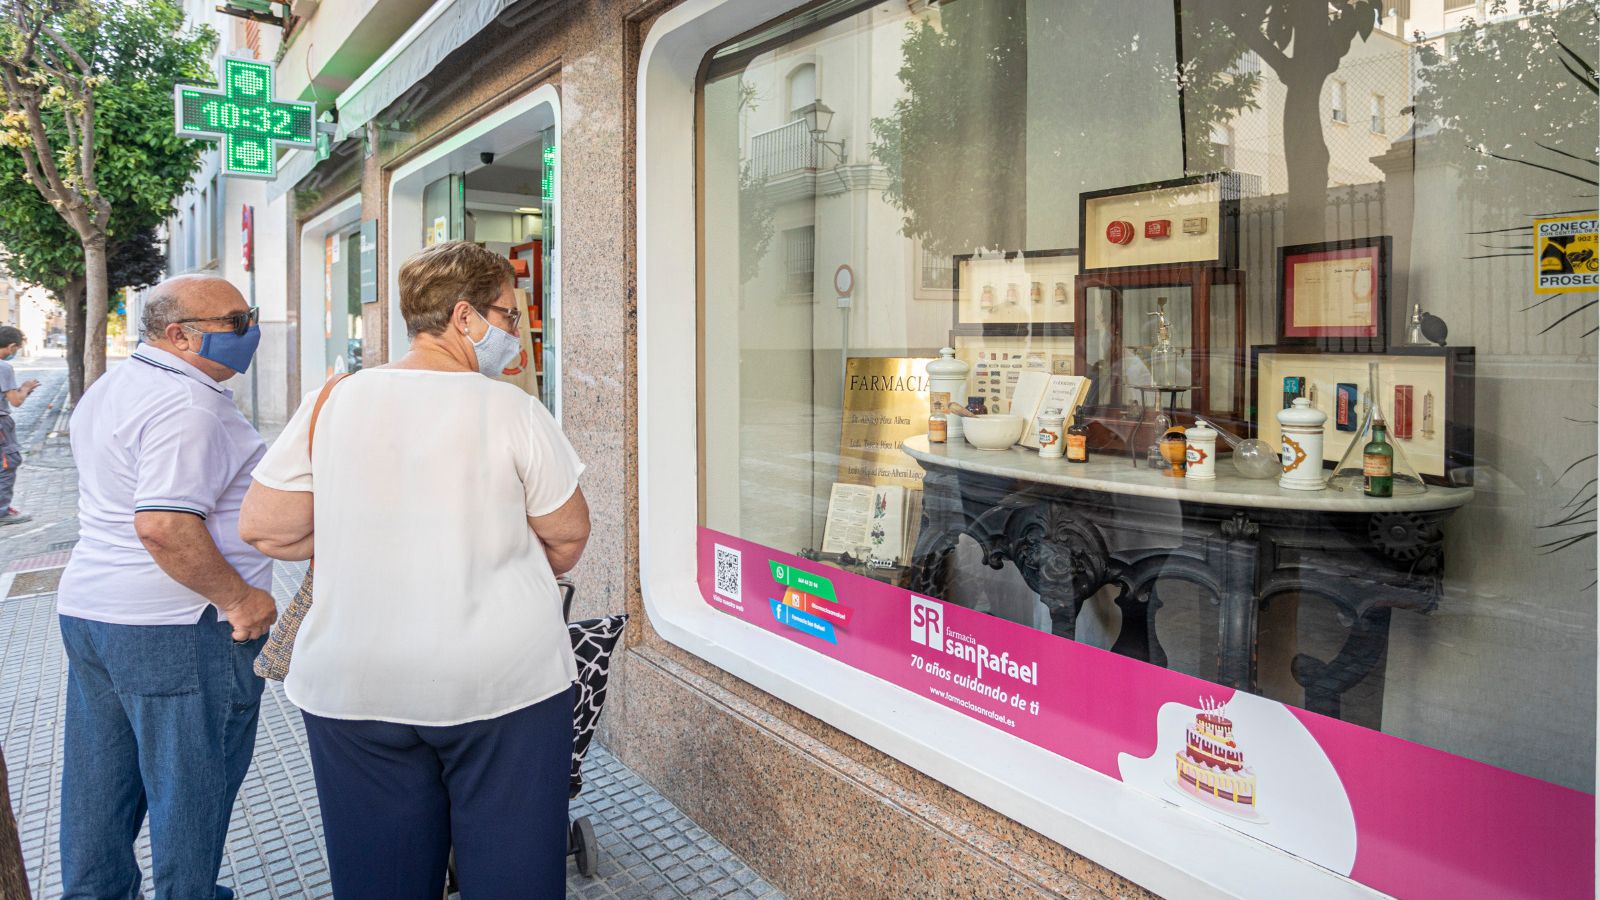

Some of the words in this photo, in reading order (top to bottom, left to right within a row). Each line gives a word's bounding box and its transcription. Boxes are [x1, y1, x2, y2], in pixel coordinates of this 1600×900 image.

[202, 101, 291, 134] 10:32
[1540, 221, 1599, 232] CONECT
[1555, 228, 1582, 236] CENTRAL
[946, 627, 976, 645] farmacia
[910, 654, 924, 670] 70
[925, 661, 951, 681] años
[953, 674, 1008, 703] cuidando
[1010, 693, 1027, 711] de
[1030, 701, 1040, 716] ti
[929, 686, 1016, 728] www.farmaciasanrafael.es
